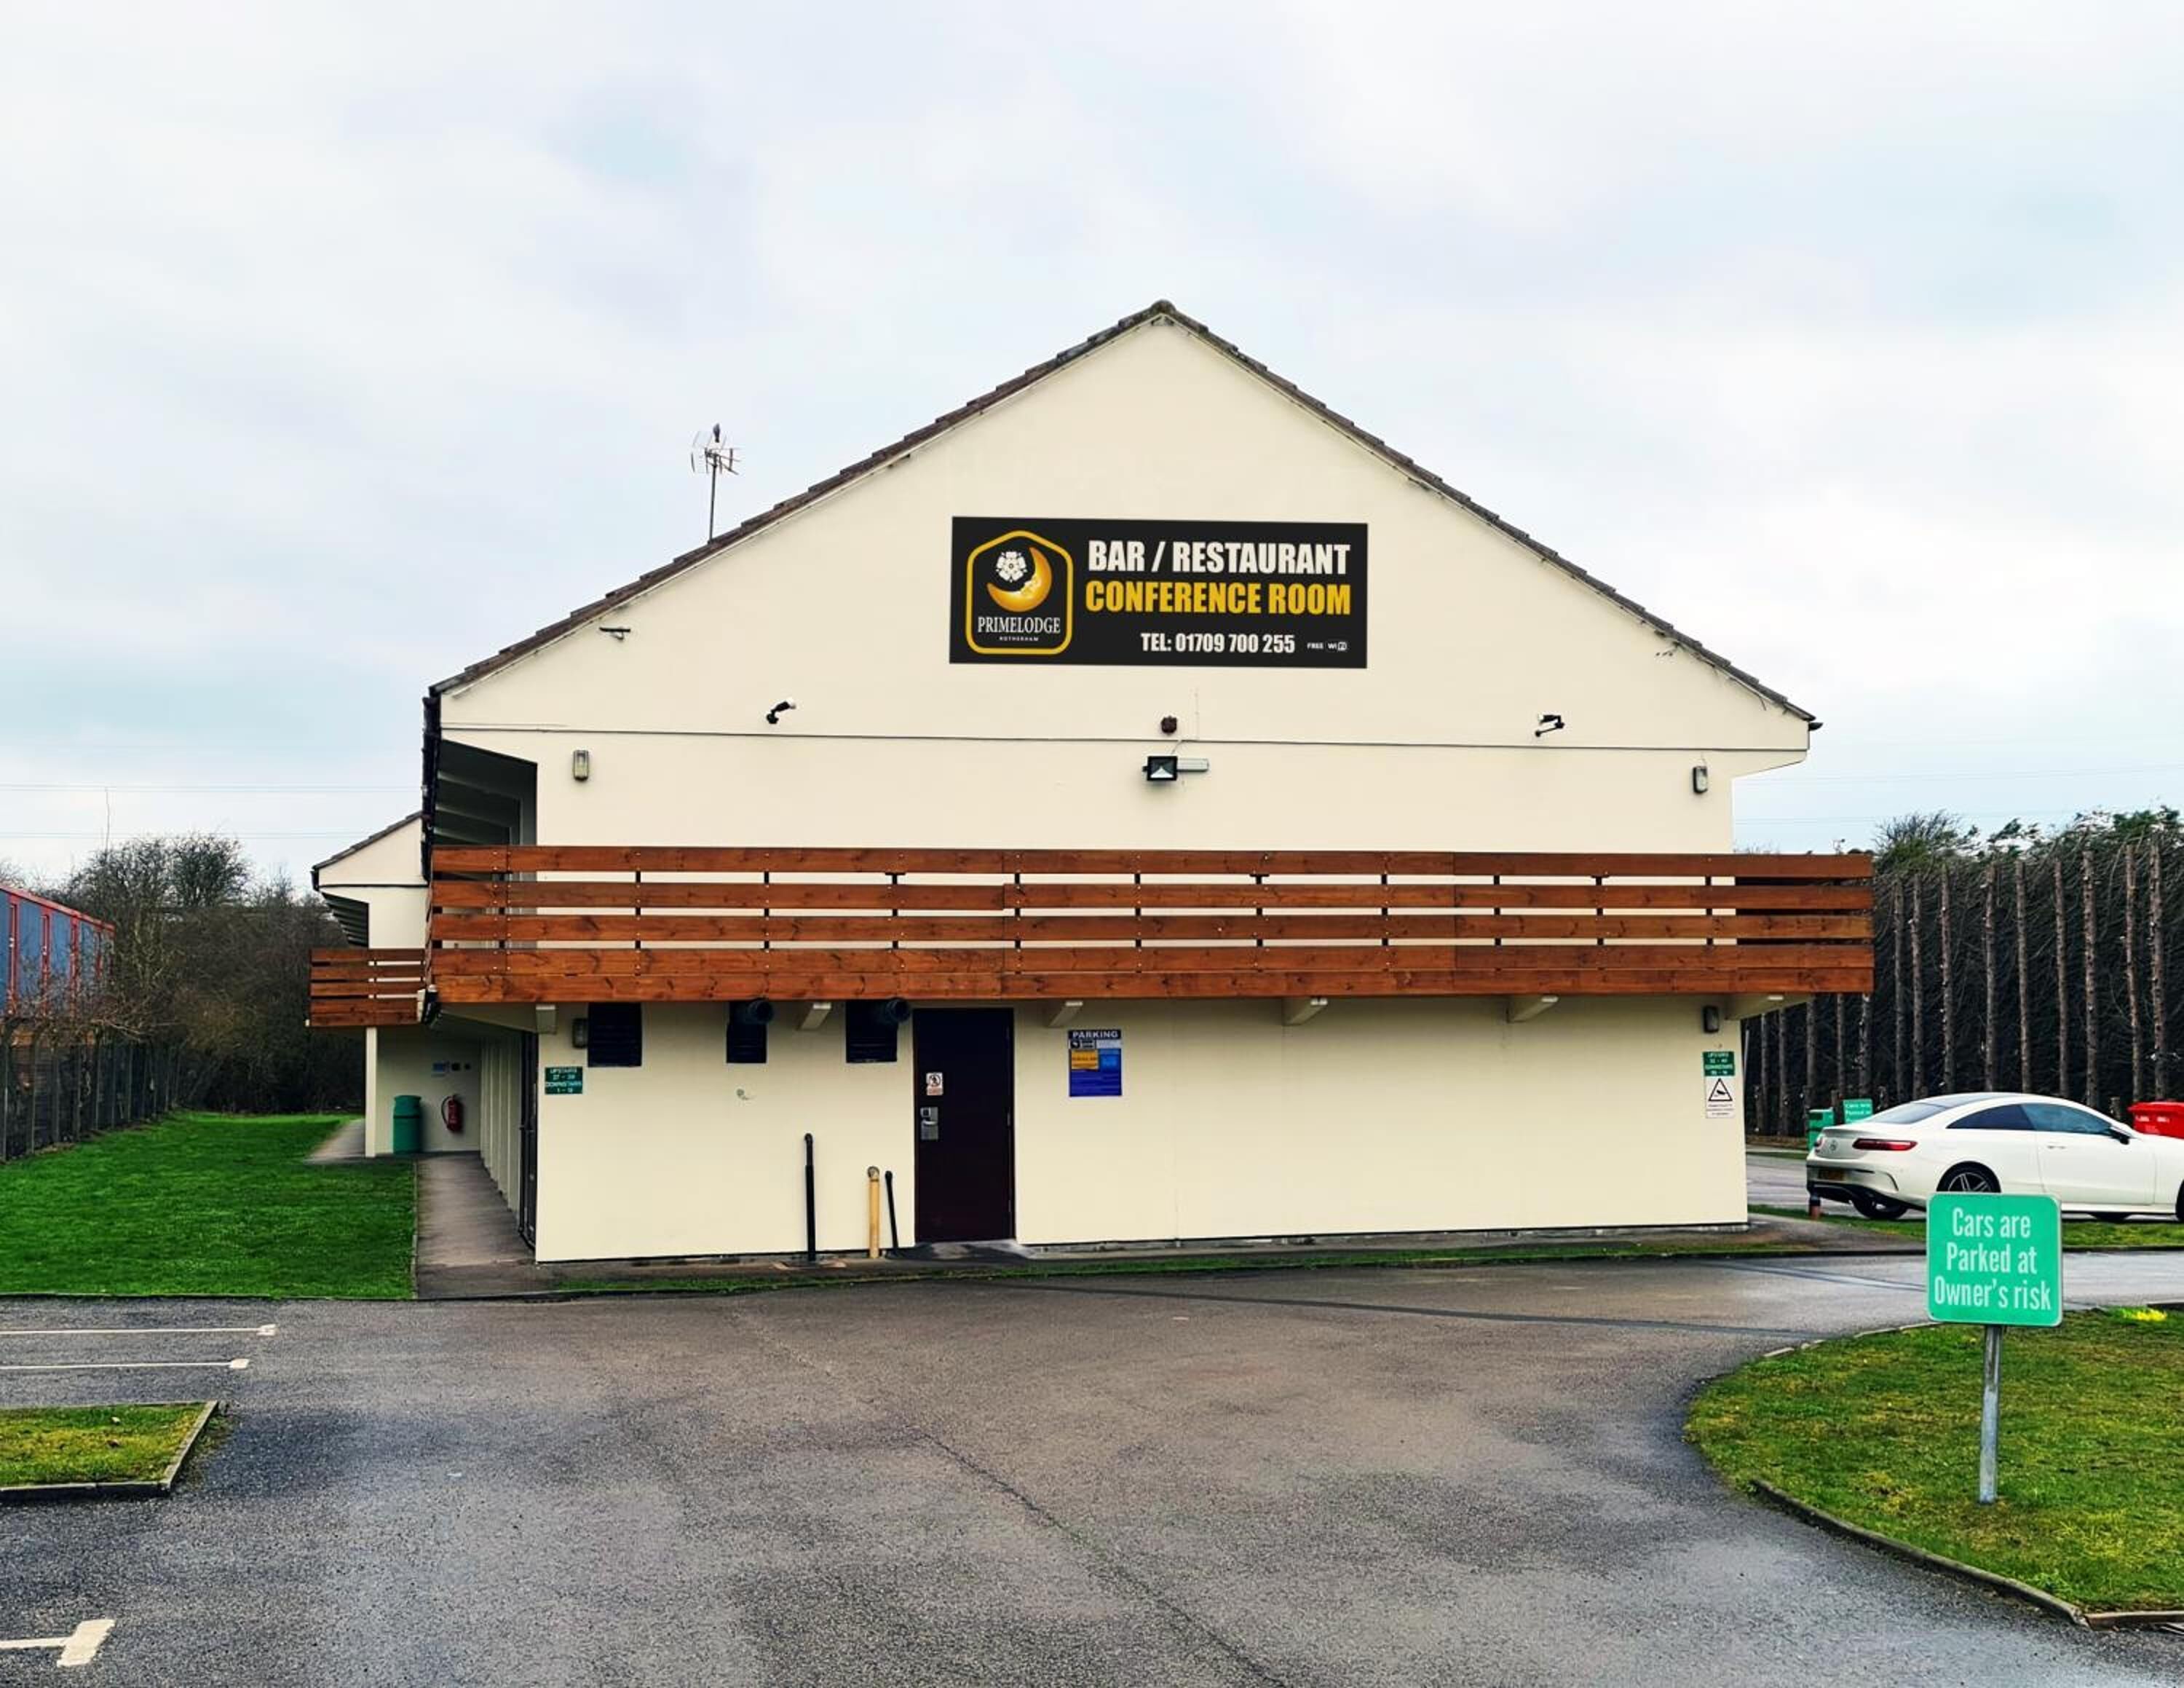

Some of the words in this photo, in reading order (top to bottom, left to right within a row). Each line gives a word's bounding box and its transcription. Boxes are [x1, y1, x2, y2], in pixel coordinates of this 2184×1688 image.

[1088, 540, 1145, 572] BAR
[1151, 540, 1166, 572] /
[1172, 541, 1351, 575] RESTAURANT
[1085, 580, 1262, 614] CONFERENCE
[1268, 583, 1351, 615] ROOM
[978, 616, 1061, 634] PRIMELODGE
[1141, 633, 1172, 652] TEL:
[1175, 633, 1225, 652] 01709
[1228, 634, 1259, 653] 700
[1262, 634, 1295, 653] 255
[1072, 1030, 1119, 1038] PARKING
[1952, 1207, 1994, 1237] Cars
[2000, 1215, 2031, 1238] are
[1946, 1242, 2011, 1273] Parked
[2017, 1246, 2037, 1274] at
[1934, 1276, 2009, 1308] Owner's
[2014, 1279, 2051, 1310] risk
